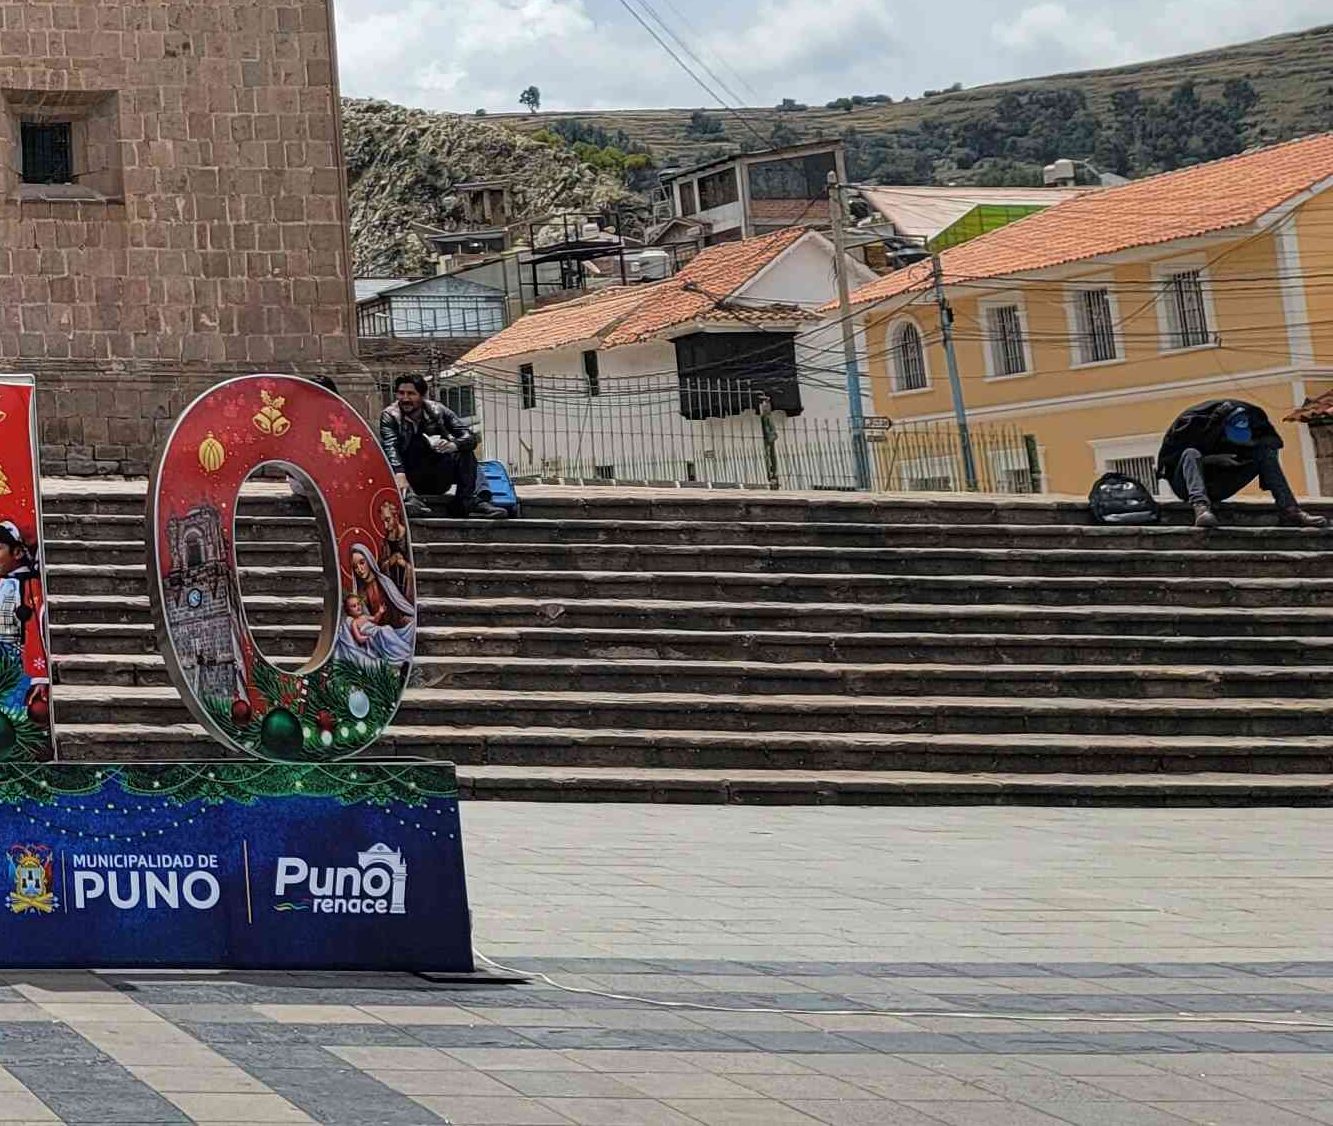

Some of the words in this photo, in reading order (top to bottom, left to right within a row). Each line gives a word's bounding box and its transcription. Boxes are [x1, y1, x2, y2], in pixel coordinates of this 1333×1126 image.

[72, 853, 195, 870] MUNICIPALIDAD
[198, 853, 219, 869] DE
[73, 870, 221, 911] PUNO
[274, 856, 393, 898] Puno
[312, 897, 389, 915] renace
